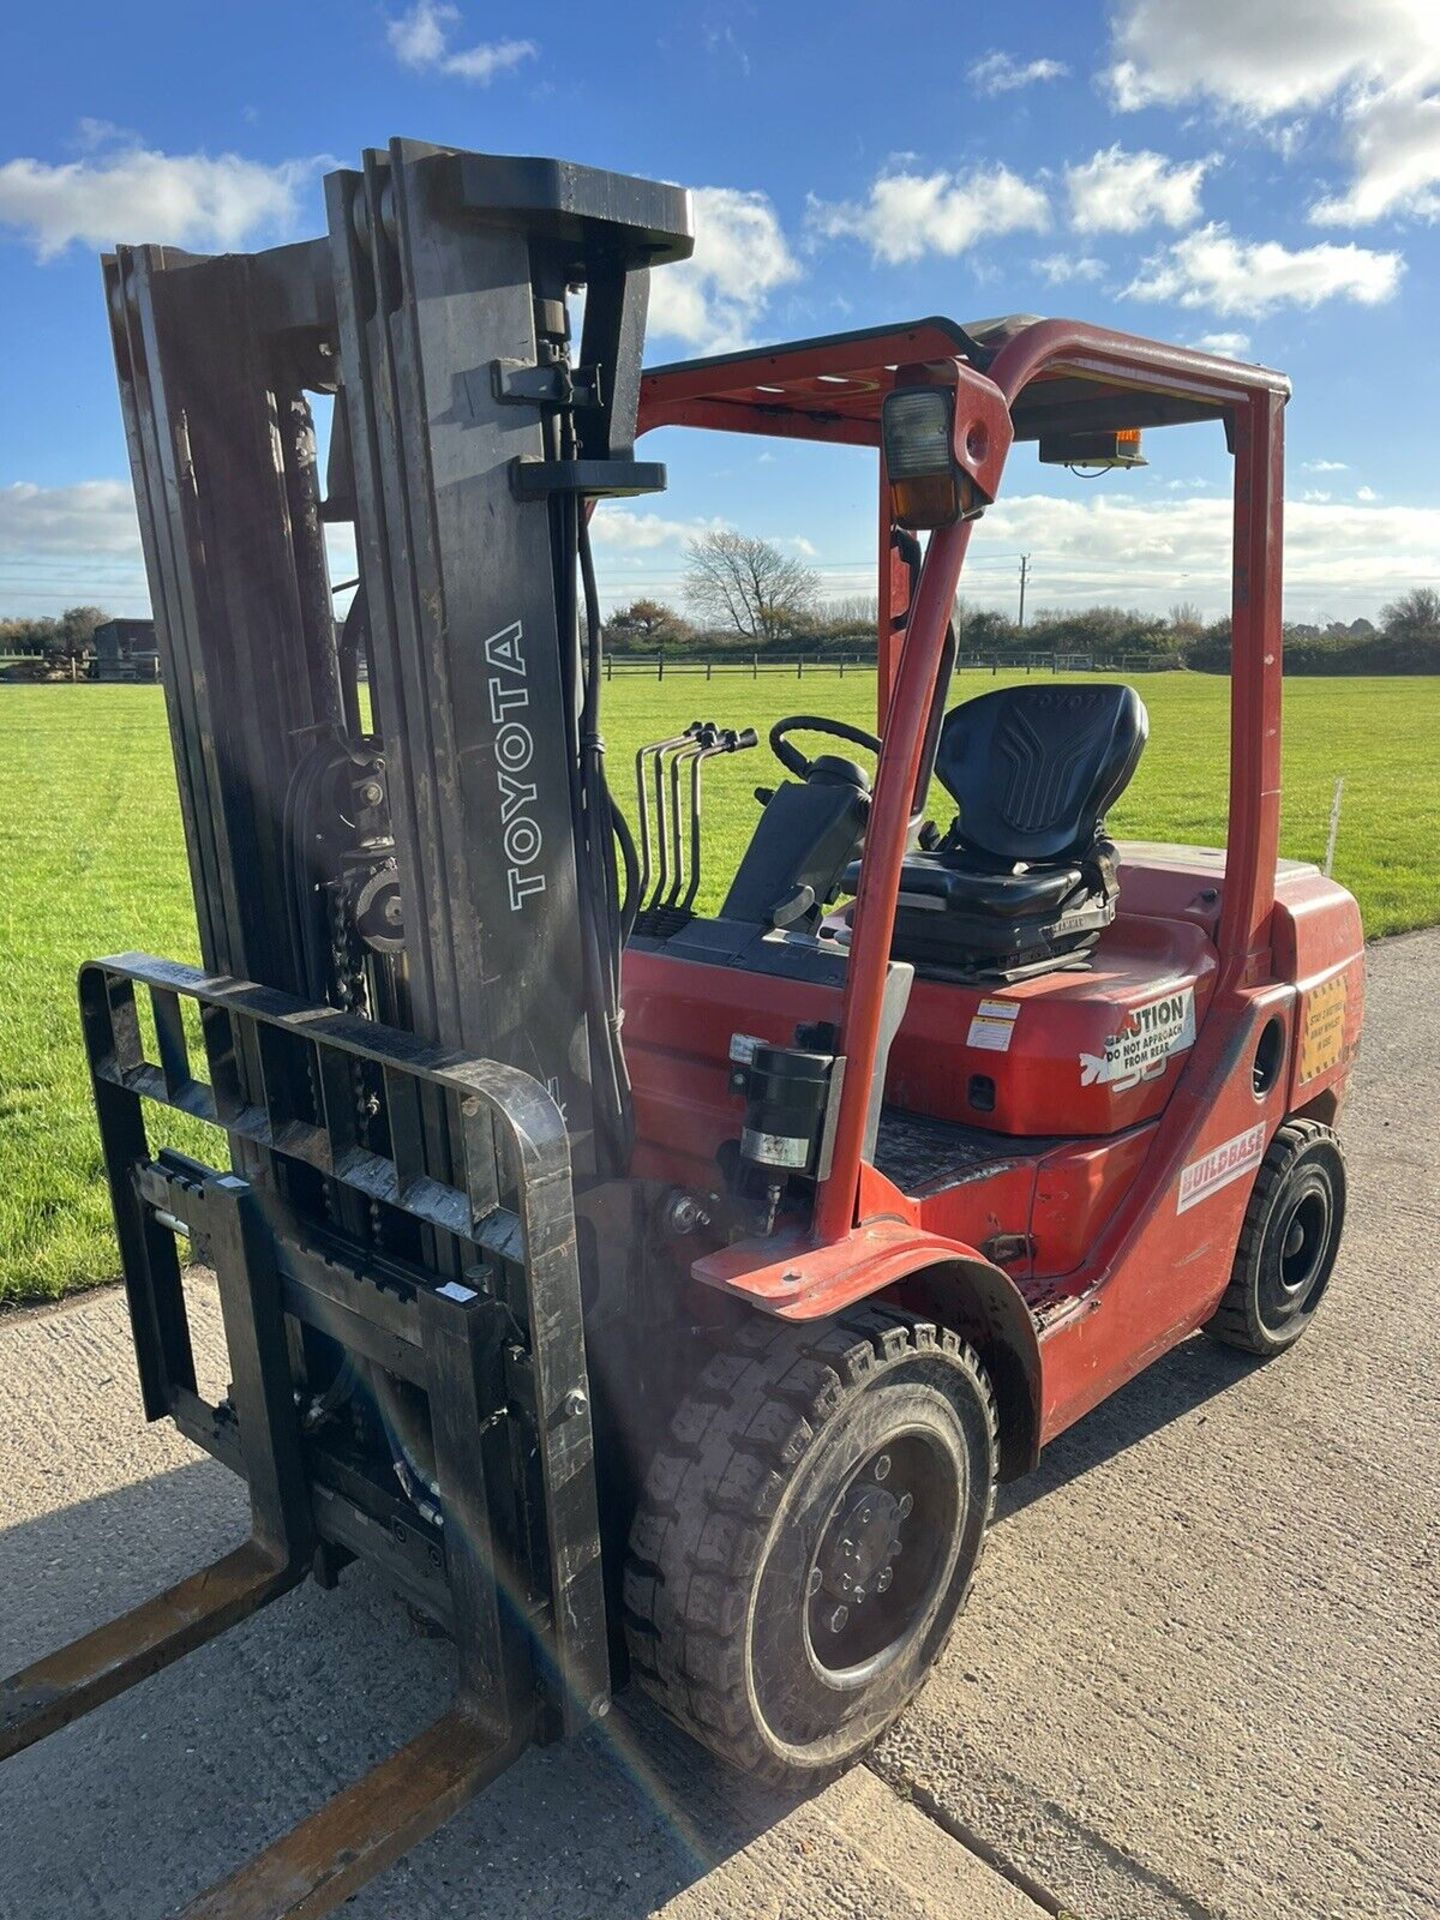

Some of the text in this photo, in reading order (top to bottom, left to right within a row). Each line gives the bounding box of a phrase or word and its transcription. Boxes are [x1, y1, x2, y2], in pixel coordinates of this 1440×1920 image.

[484, 619, 546, 911] TOYOTA
[1107, 1023, 1184, 1062] DO NOT APPROACH
[1124, 1042, 1170, 1069] FROM REAR
[1183, 1126, 1264, 1194] BUILDBASE
